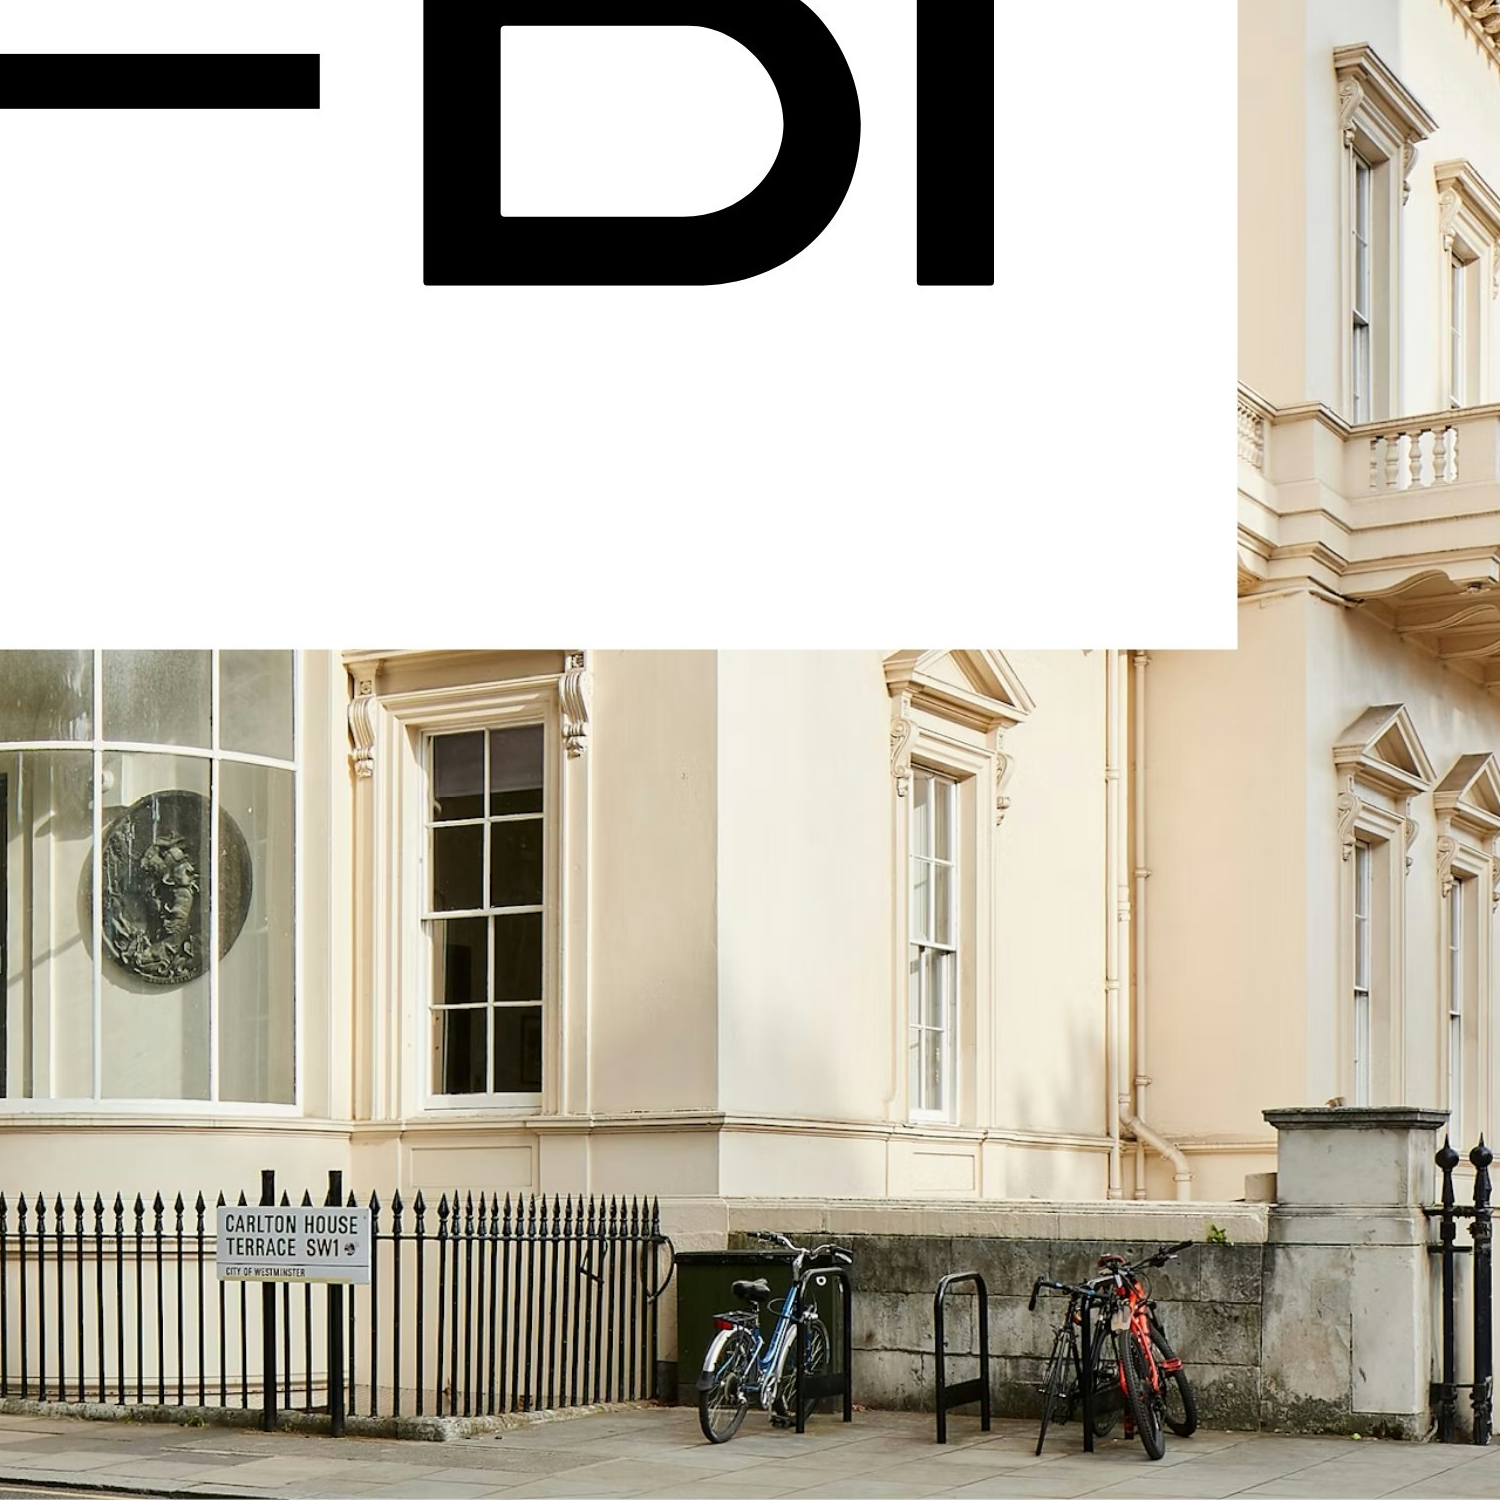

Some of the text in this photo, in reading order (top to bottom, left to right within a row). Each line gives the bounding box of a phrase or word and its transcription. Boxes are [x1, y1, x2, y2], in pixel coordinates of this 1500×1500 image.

[225, 1213, 358, 1235] CARLTON HOUSE
[225, 1237, 339, 1257] TERRACE SW1
[225, 1266, 306, 1278] CITY OF WESTMINSTER
